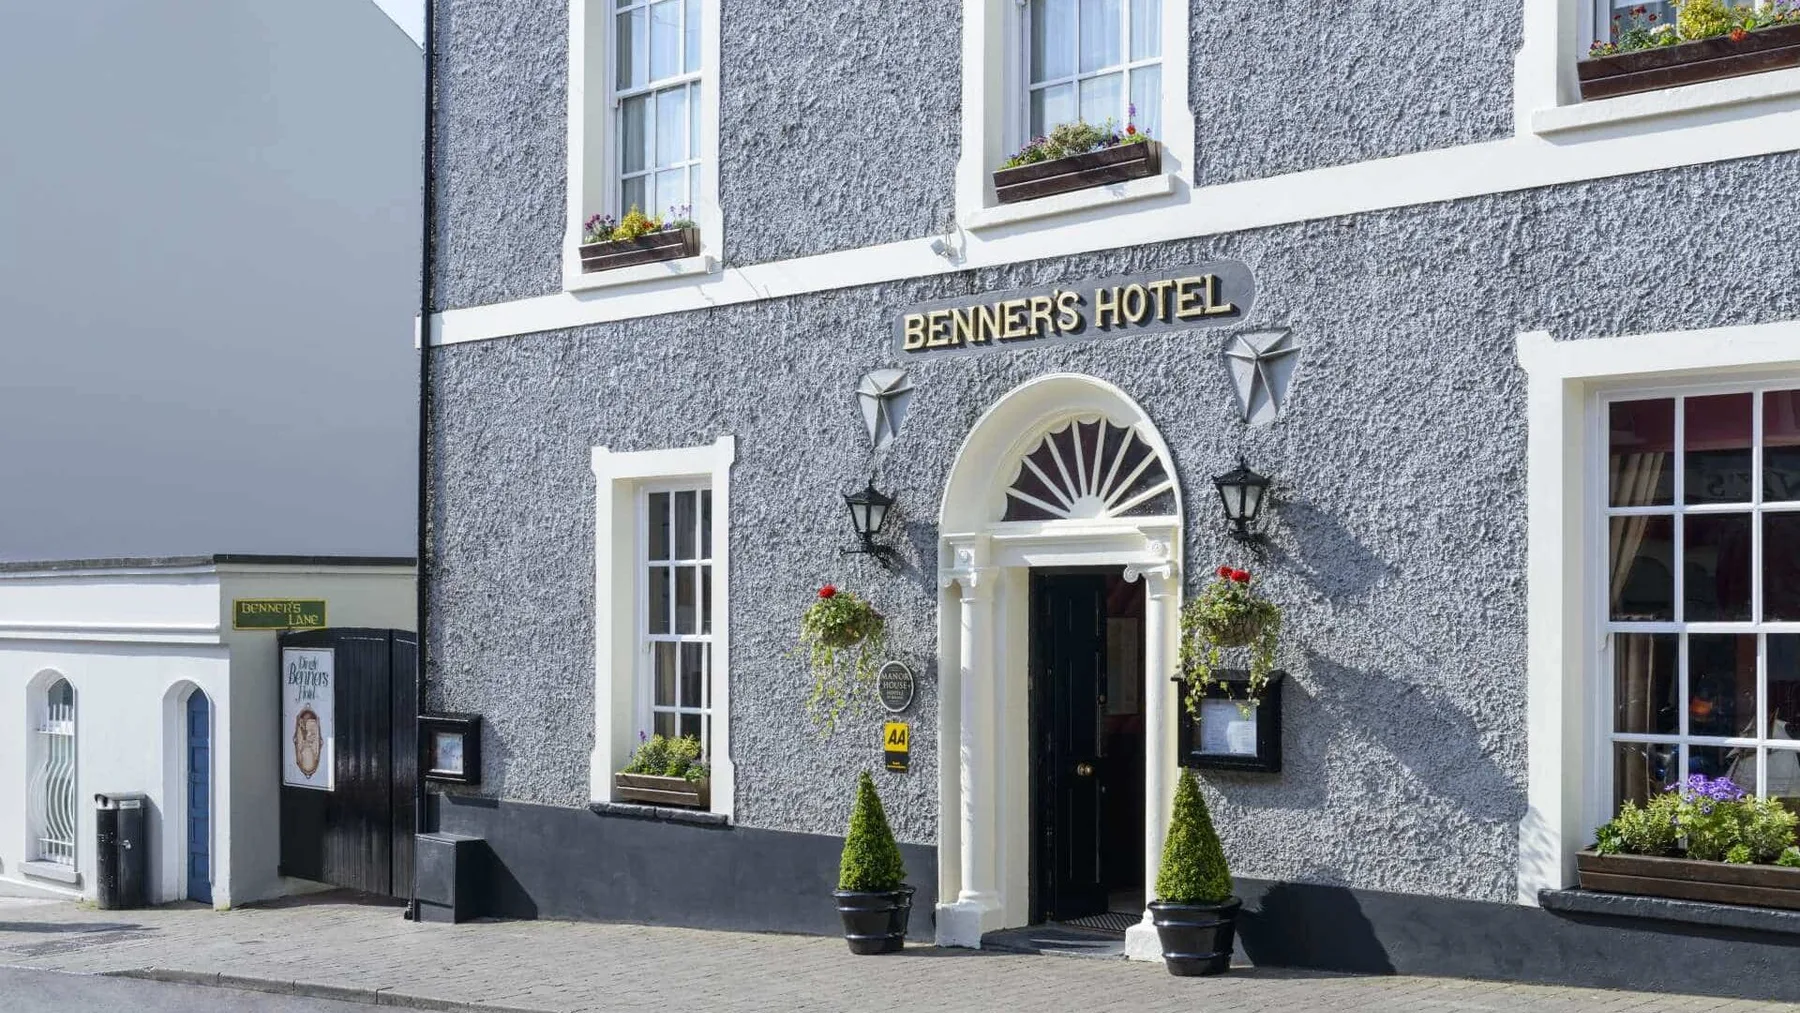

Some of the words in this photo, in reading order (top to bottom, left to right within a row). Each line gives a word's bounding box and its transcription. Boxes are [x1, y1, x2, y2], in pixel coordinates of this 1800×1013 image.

[903, 288, 1081, 351] BENNER'S
[1094, 273, 1234, 327] HOTEL
[241, 601, 301, 614] BENNER'S
[288, 613, 319, 626] LANE
[881, 672, 909, 680] MANOR
[883, 681, 908, 690] HOUSE
[888, 728, 906, 746] AA
